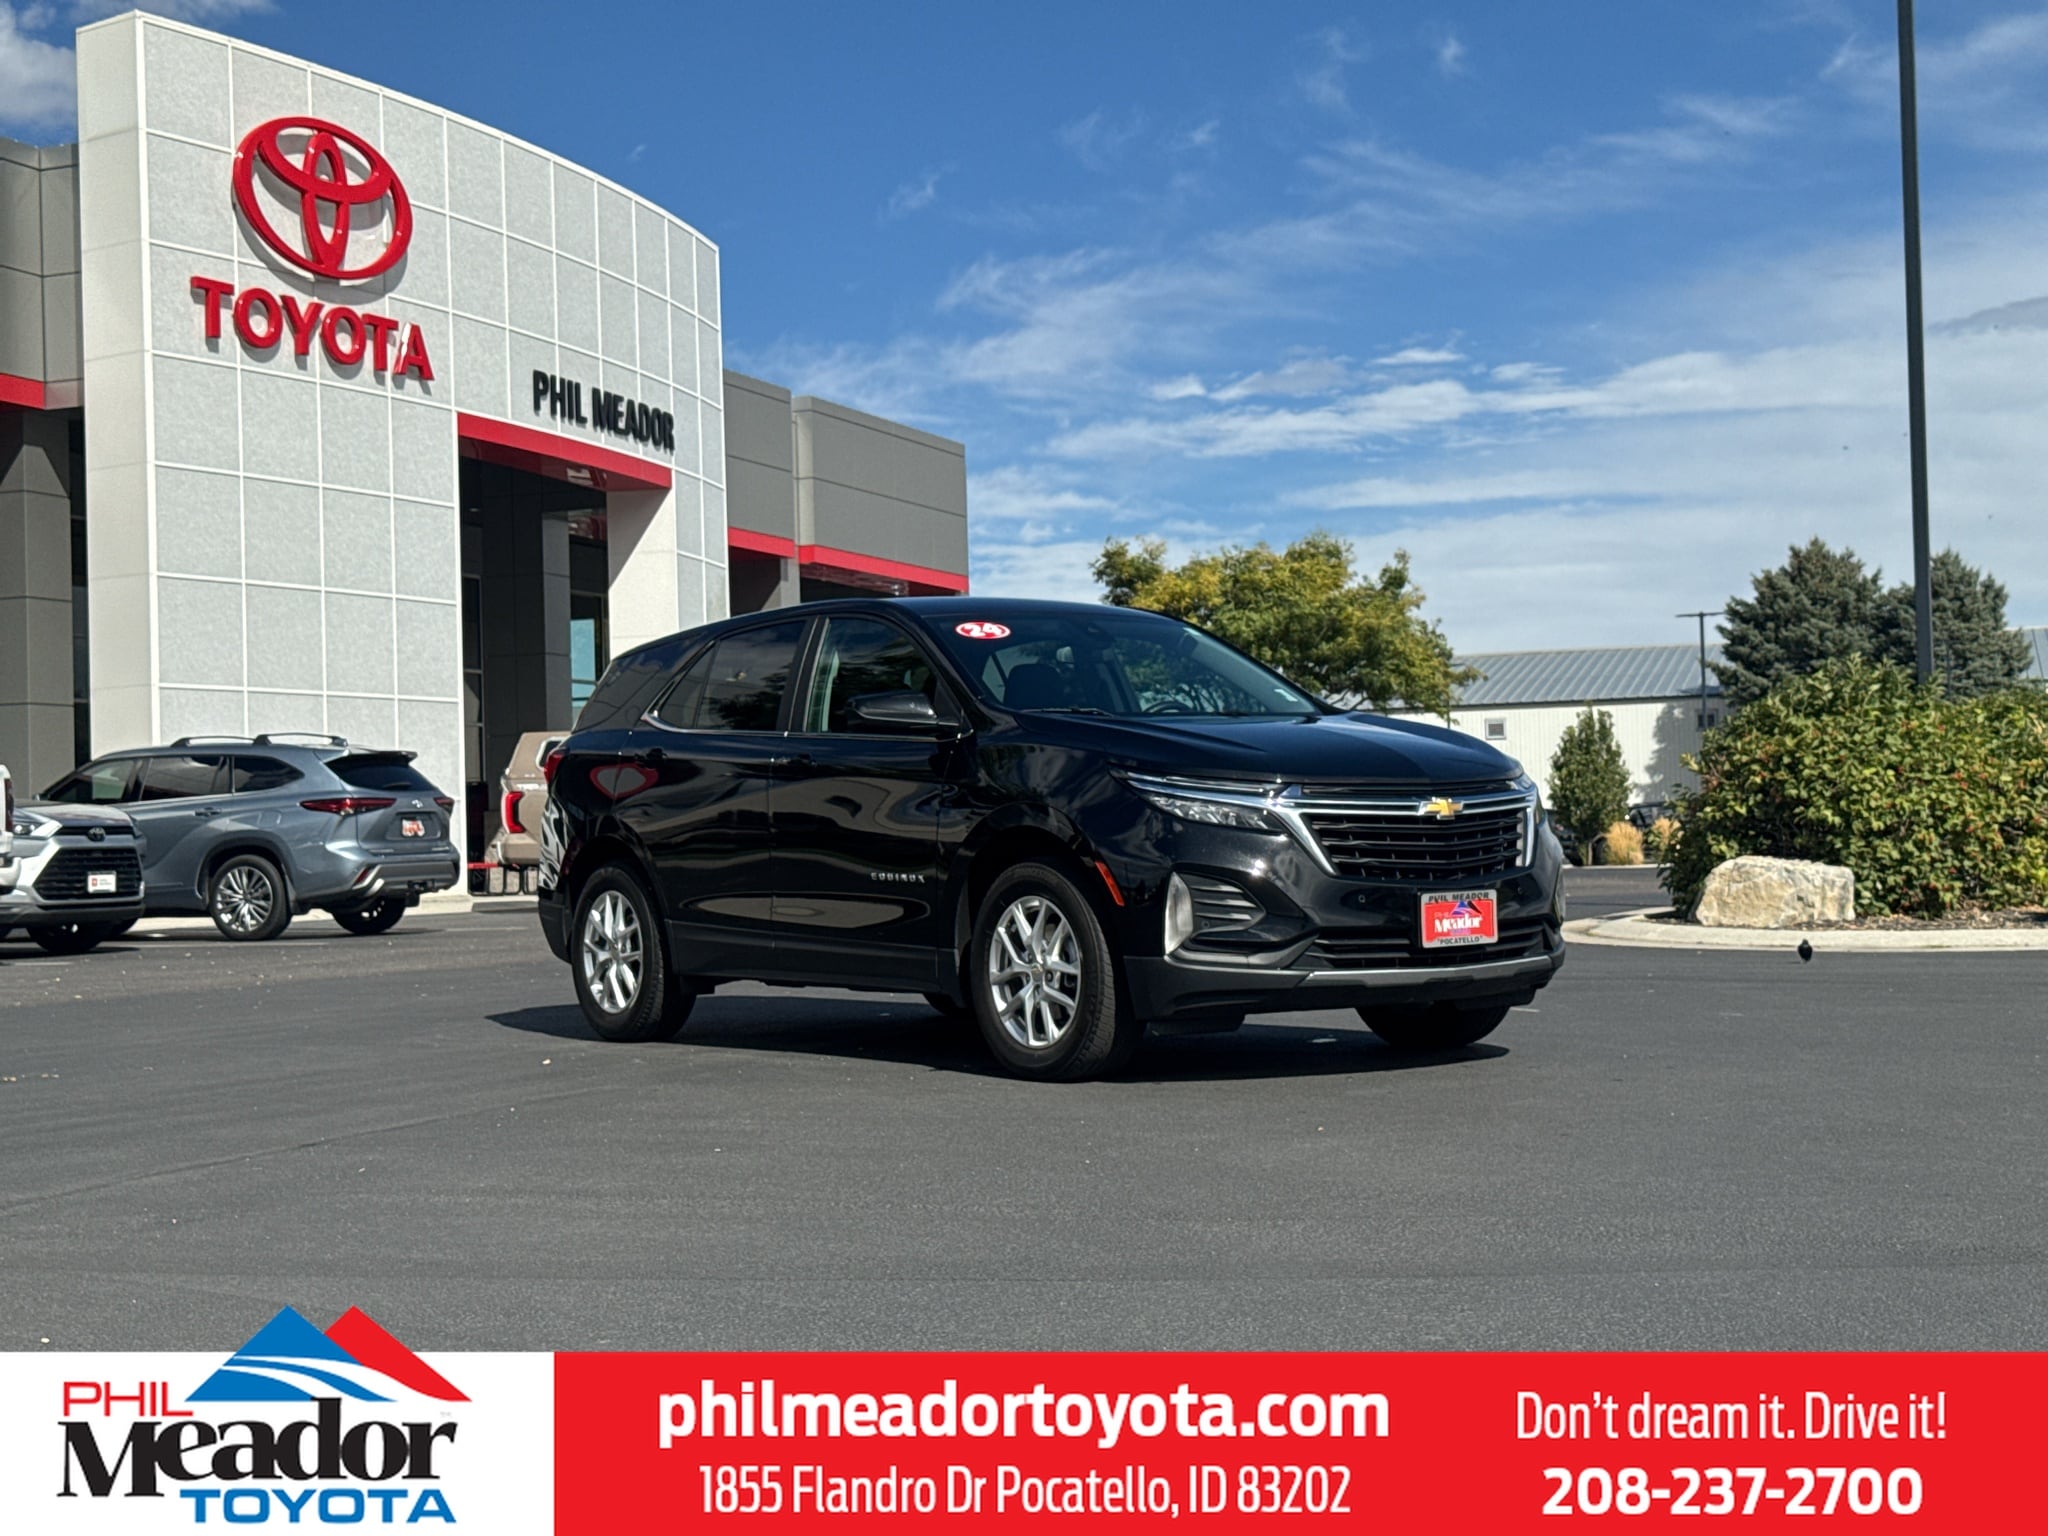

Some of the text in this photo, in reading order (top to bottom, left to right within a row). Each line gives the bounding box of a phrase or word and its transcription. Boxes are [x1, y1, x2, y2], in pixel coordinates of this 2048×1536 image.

[190, 276, 435, 381] TOYOTA
[533, 369, 675, 451] PHIL MEADOR
[1452, 892, 1489, 901] MEADOR
